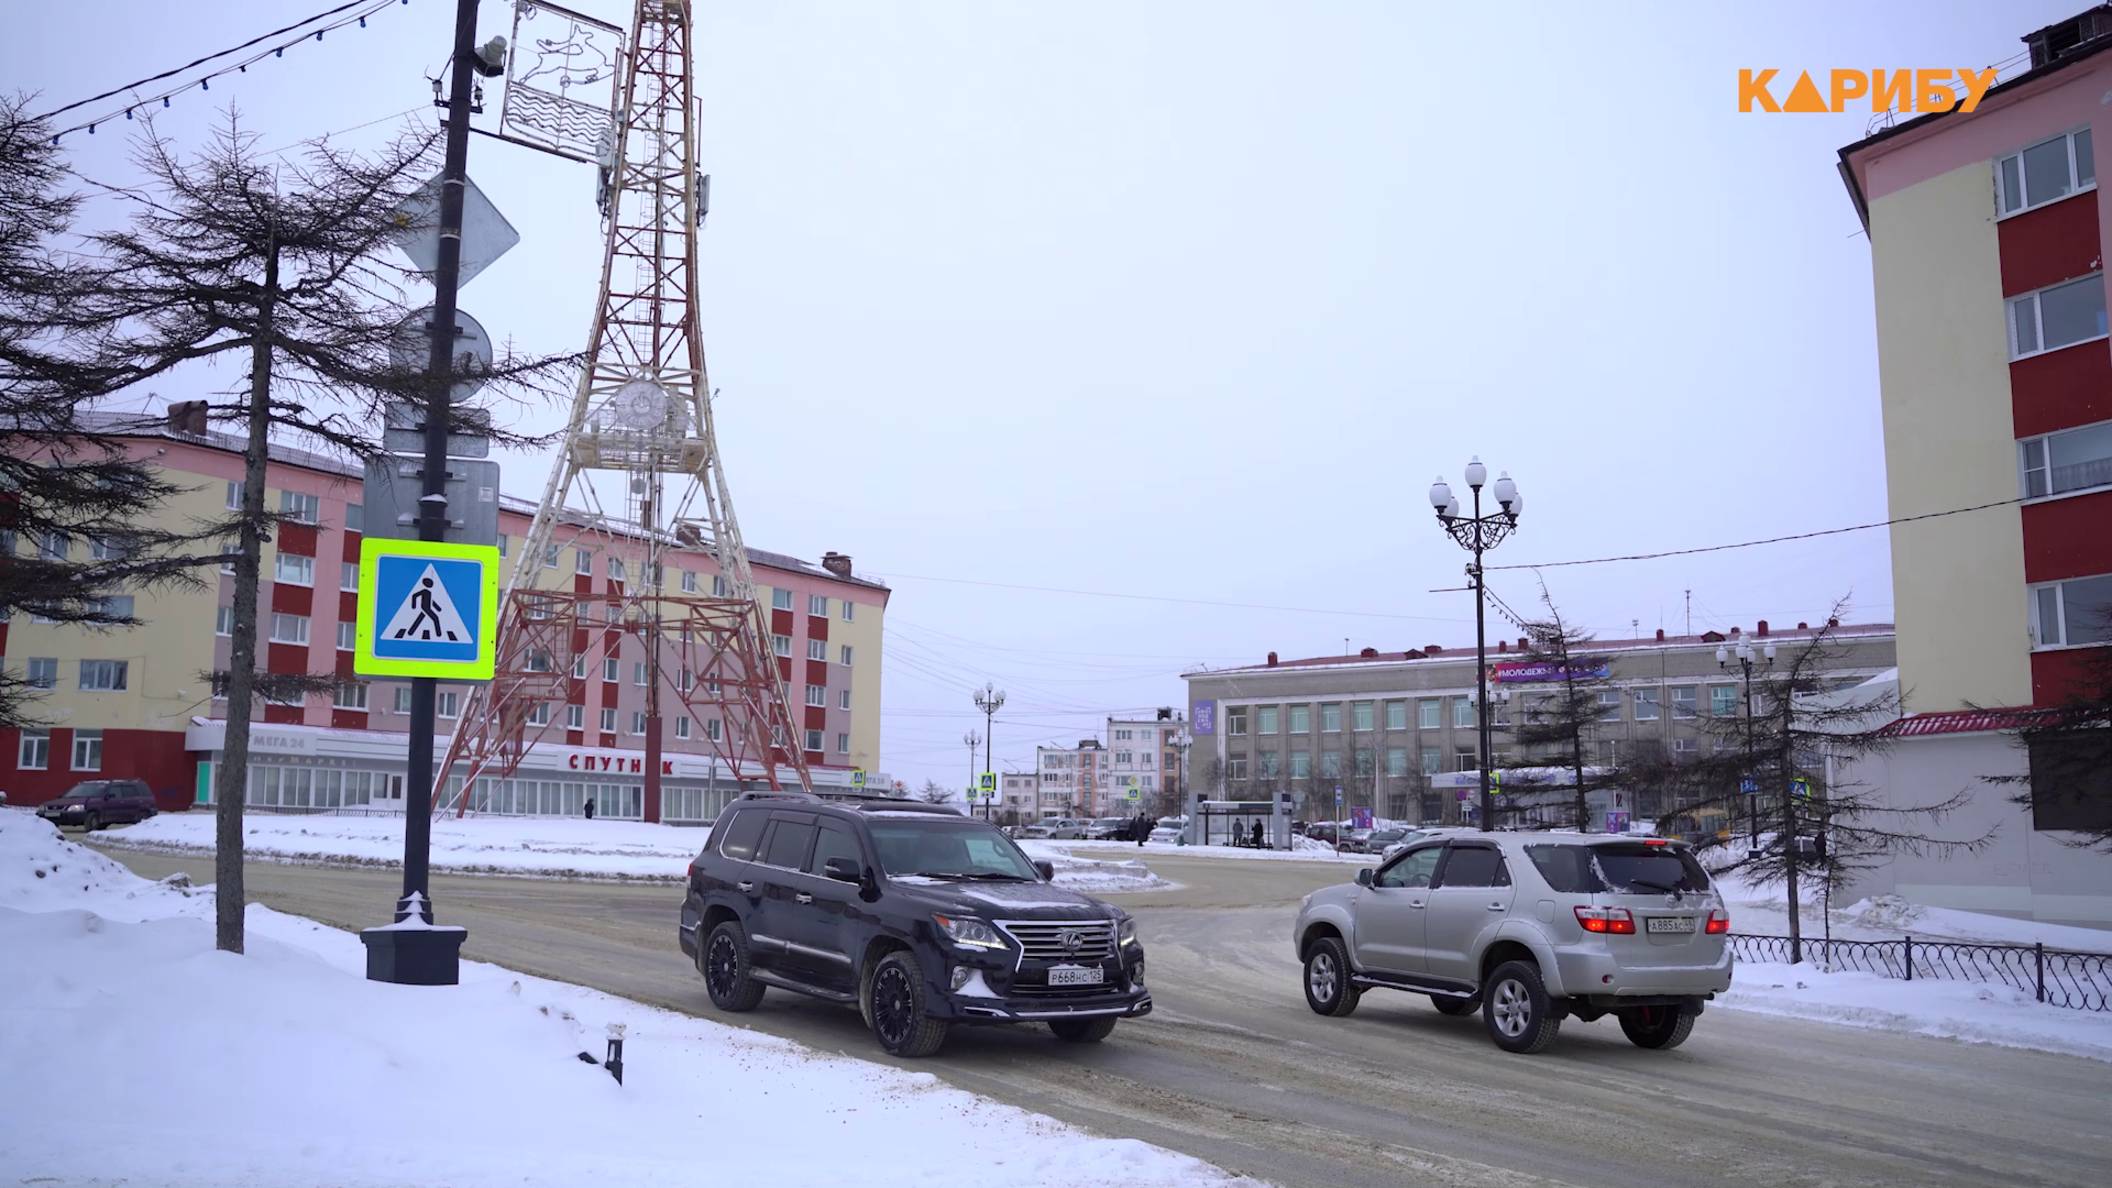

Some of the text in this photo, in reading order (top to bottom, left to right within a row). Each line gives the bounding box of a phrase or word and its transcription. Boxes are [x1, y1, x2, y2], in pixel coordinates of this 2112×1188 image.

[252, 735, 305, 749] МЕГА 24
[568, 753, 673, 775] СПУТНК
